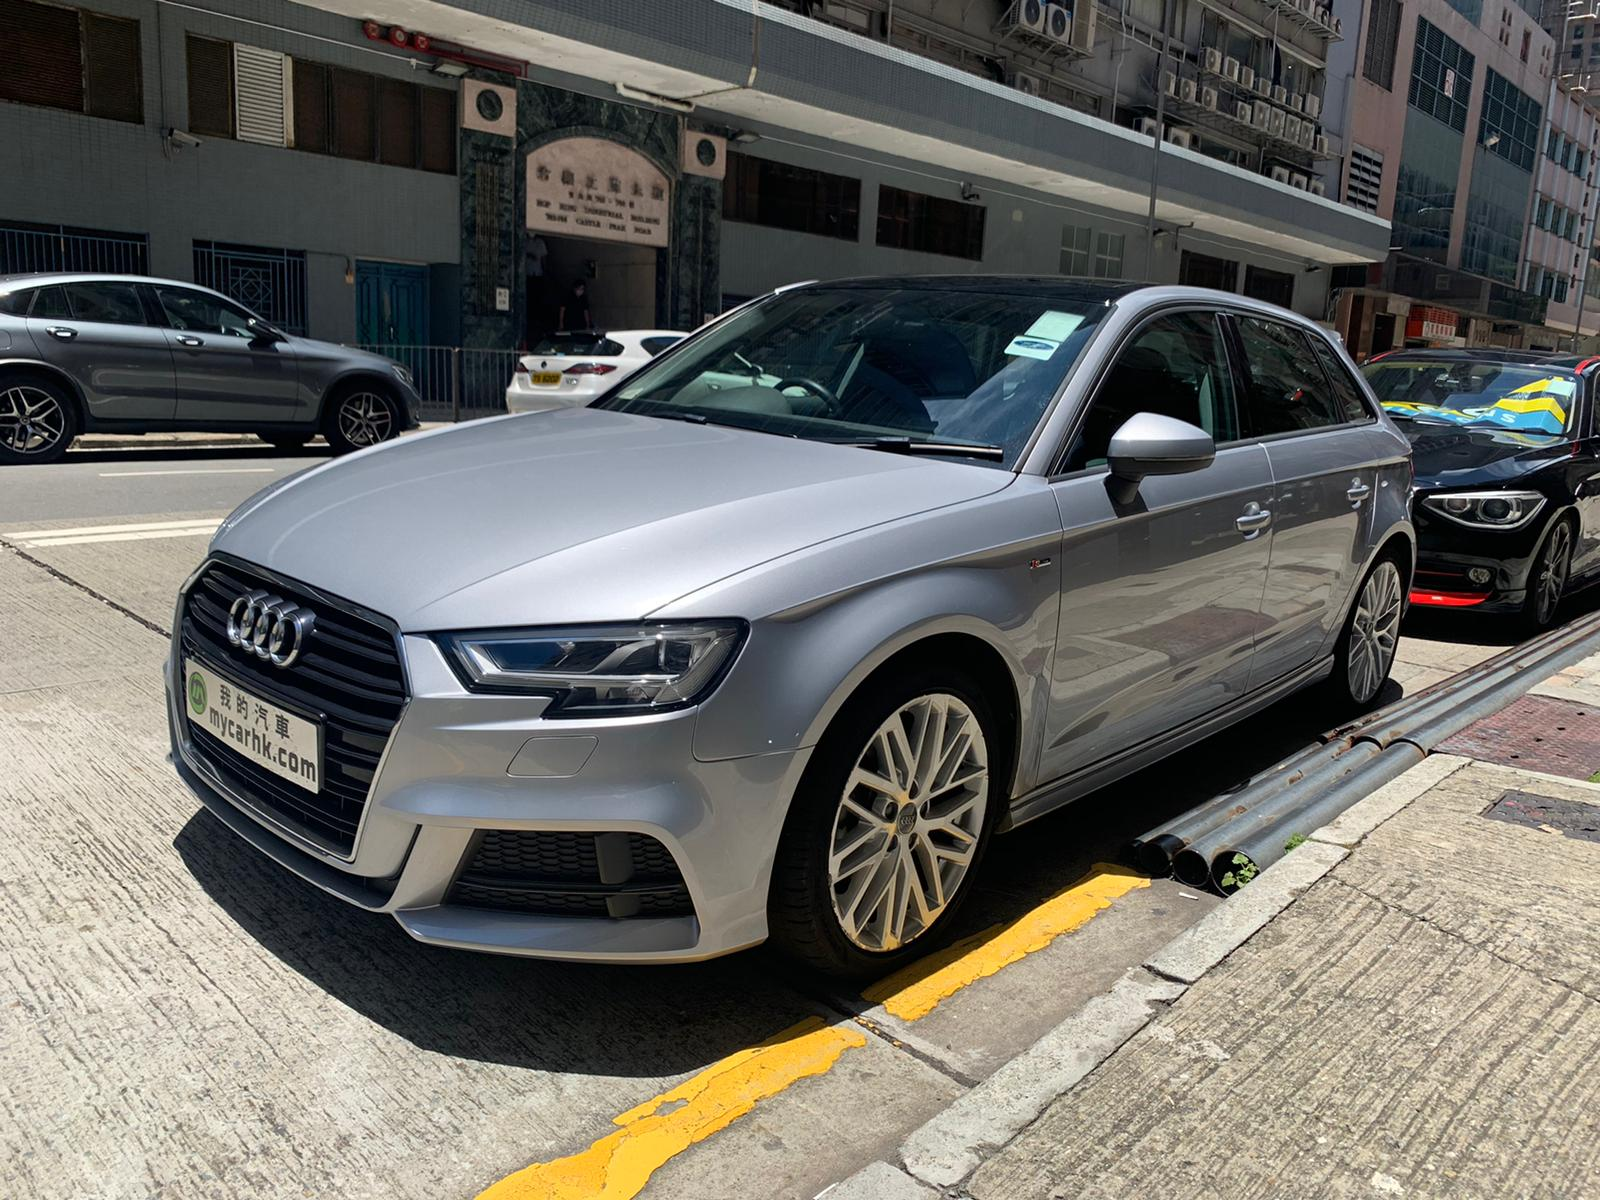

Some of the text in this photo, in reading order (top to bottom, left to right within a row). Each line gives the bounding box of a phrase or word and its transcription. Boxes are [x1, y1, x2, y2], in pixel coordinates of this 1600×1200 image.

[209, 706, 316, 783] mycarhk.com
[220, 684, 290, 740] 我的汽車
